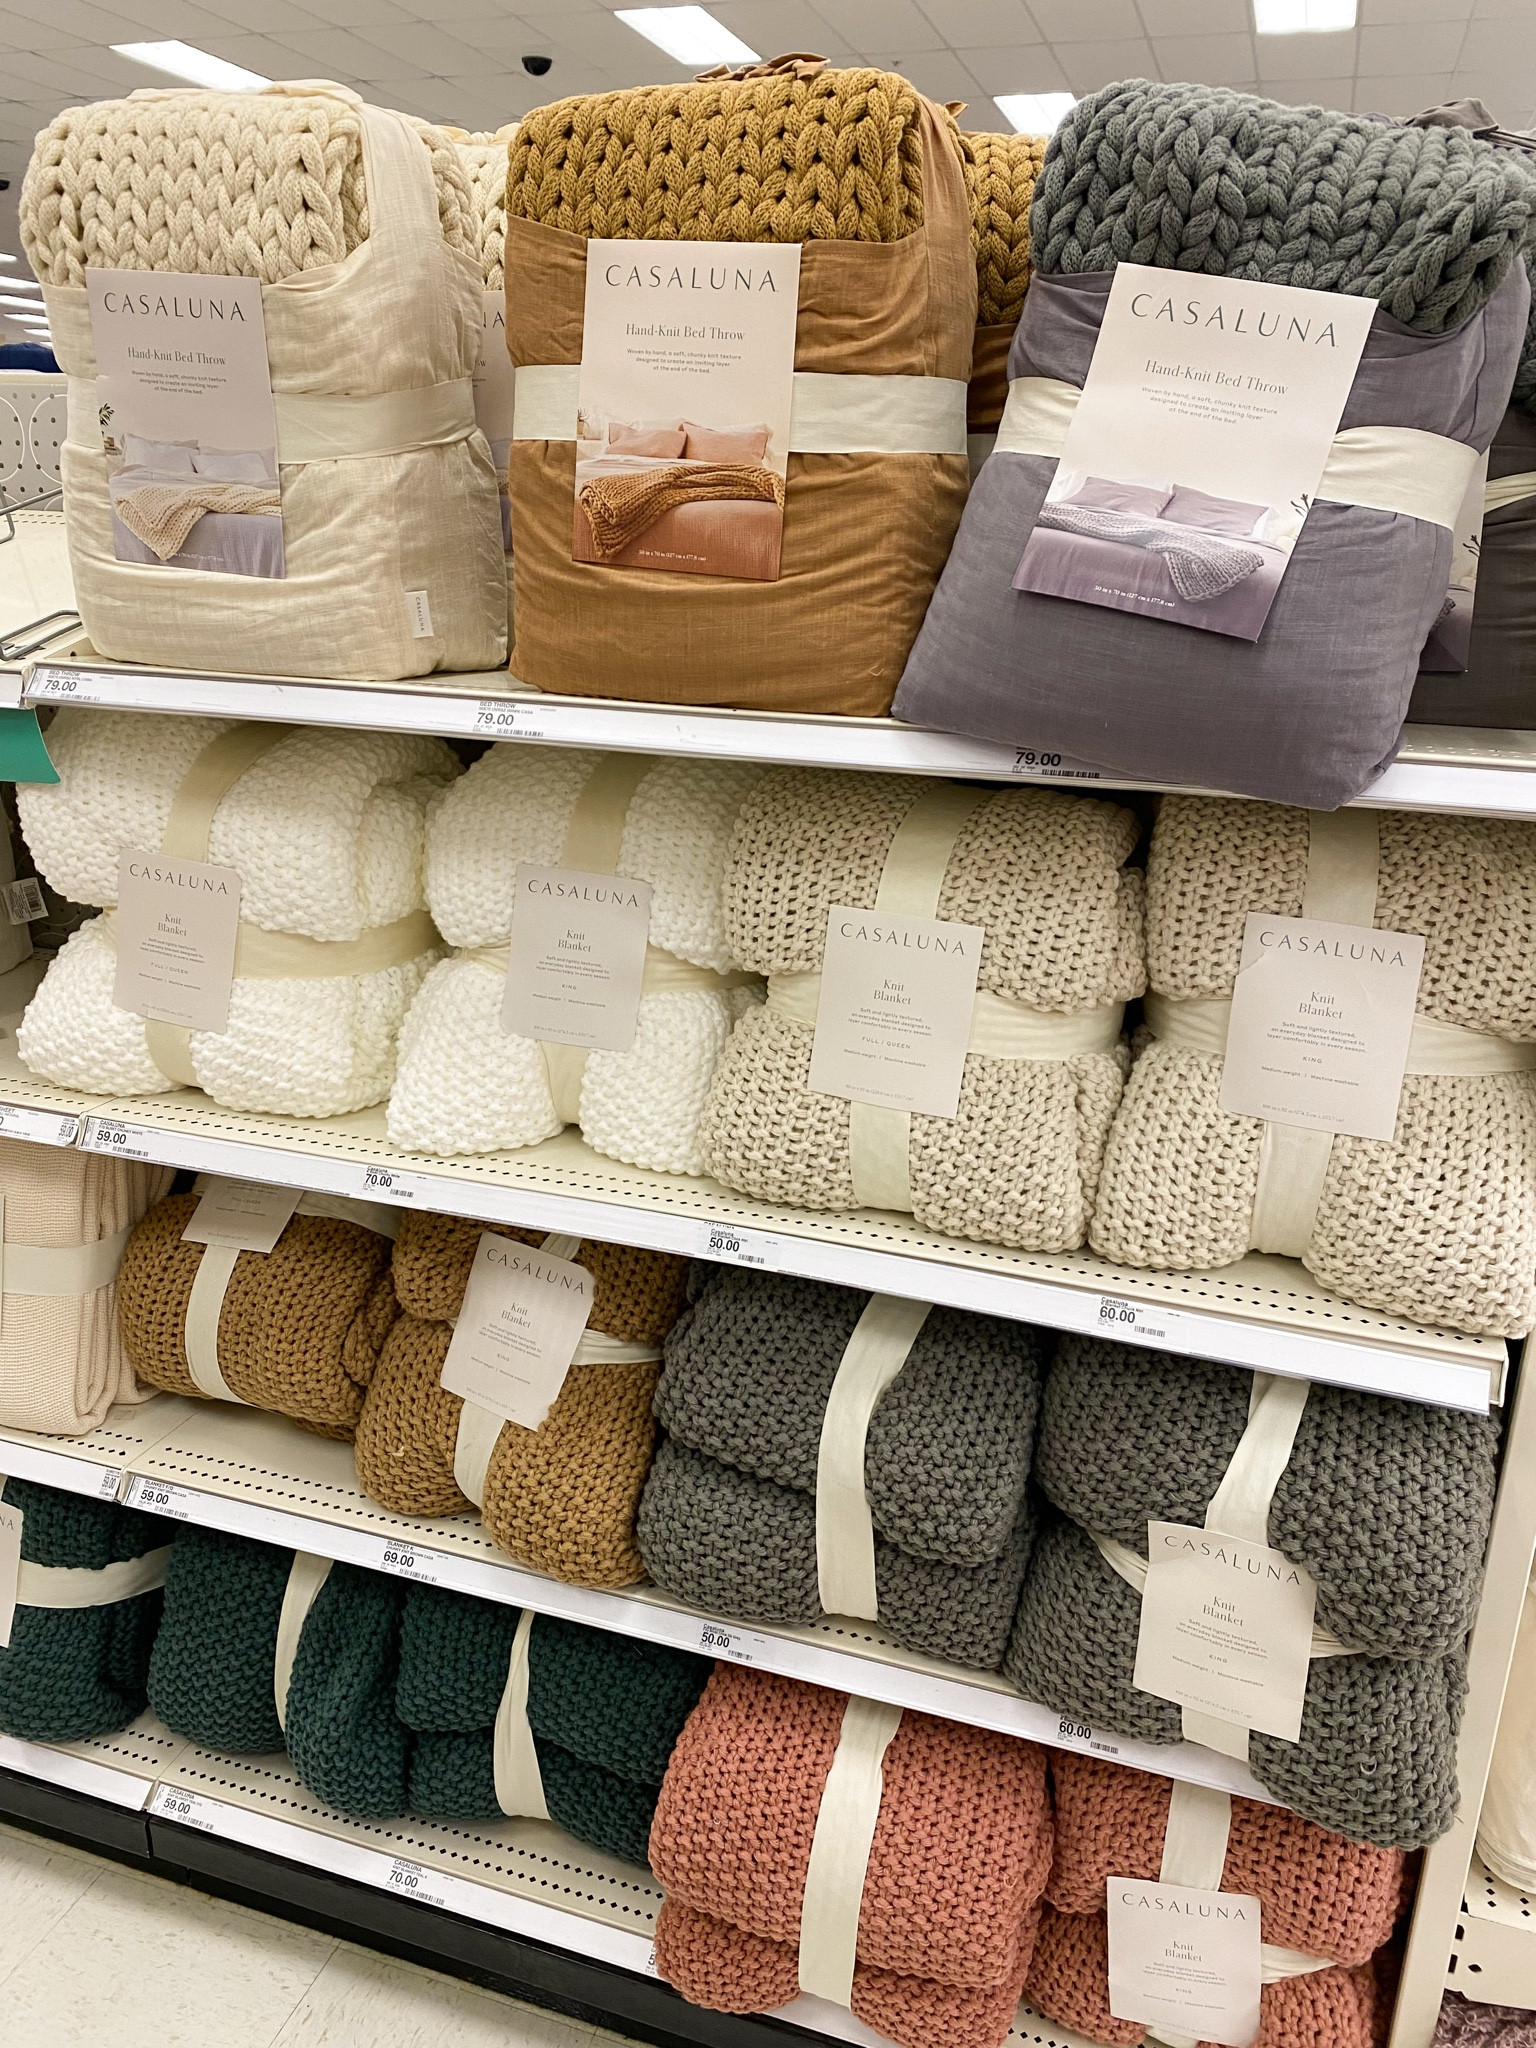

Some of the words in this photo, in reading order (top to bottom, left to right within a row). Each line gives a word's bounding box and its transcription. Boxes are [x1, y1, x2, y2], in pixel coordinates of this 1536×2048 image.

[605, 264, 777, 292] CASALUNA
[104, 292, 245, 321] CASALUNA
[1131, 293, 1337, 348] CASALUNA
[626, 323, 680, 337] Hand-Knit
[684, 326, 705, 338] Bed
[710, 326, 745, 340] Throw
[128, 347, 172, 361] Hand-Knit
[174, 350, 193, 363] Bed
[195, 352, 226, 365] Throw
[1145, 360, 1211, 382] Hand-Knit
[1215, 371, 1242, 387] Bed
[1247, 376, 1288, 394] Throw
[1172, 391, 1189, 399] hand,
[1197, 396, 1212, 404] soft,
[1214, 399, 1236, 408] chunky
[1253, 406, 1277, 414] texture
[416, 597, 424, 631] CASALUNA
[45, 680, 77, 691] 79.00
[477, 712, 514, 725] 79.00
[1016, 752, 1061, 766] 79.00
[129, 864, 228, 895] CASALUNA
[528, 880, 638, 907] CASALUNA
[165, 914, 181, 925] Knit
[158, 922, 187, 936] Blanket
[567, 930, 585, 940] Knit
[558, 939, 592, 952] Blanket
[841, 923, 964, 955] CASALUNA
[1260, 931, 1404, 967] CASALUNA
[883, 979, 904, 991] Knit
[873, 990, 912, 1005] Blanket
[1311, 992, 1335, 1005] Knit
[1299, 1003, 1343, 1019] Blanket
[862, 1036, 879, 1044] FULL
[887, 1041, 911, 1049] QUEEN
[1303, 1056, 1323, 1064] KING
[100, 1120, 125, 1128] CASALUNA
[97, 1130, 126, 1145] 59.00
[366, 1174, 392, 1187] 70.00
[709, 1237, 739, 1252] 50.00
[487, 1248, 584, 1294] CASALUNA
[511, 1302, 528, 1316] Knit
[1100, 1306, 1135, 1323] 60.00
[501, 1310, 532, 1328] Blanket
[145, 1480, 165, 1488] BLANKET
[141, 1489, 169, 1505] 59.00
[387, 1541, 409, 1549] BLANKET
[384, 1551, 414, 1567] 69.00
[1165, 1535, 1301, 1585] CASALUNA
[1213, 1596, 1236, 1612] Knit
[1203, 1605, 1243, 1627] Blanket
[702, 1632, 729, 1647] 50.00
[1209, 1654, 1228, 1663] KING
[1060, 1721, 1091, 1739] 60.00
[169, 1788, 195, 1799] CASALUNA
[163, 1798, 190, 1814] 59.00
[395, 1860, 422, 1872] CASALUNA
[390, 1870, 418, 1888] 70.00
[1122, 1893, 1246, 1920] CASALUNA
[1173, 1941, 1193, 1951] Knit
[1165, 1949, 1202, 1962] Blanket
